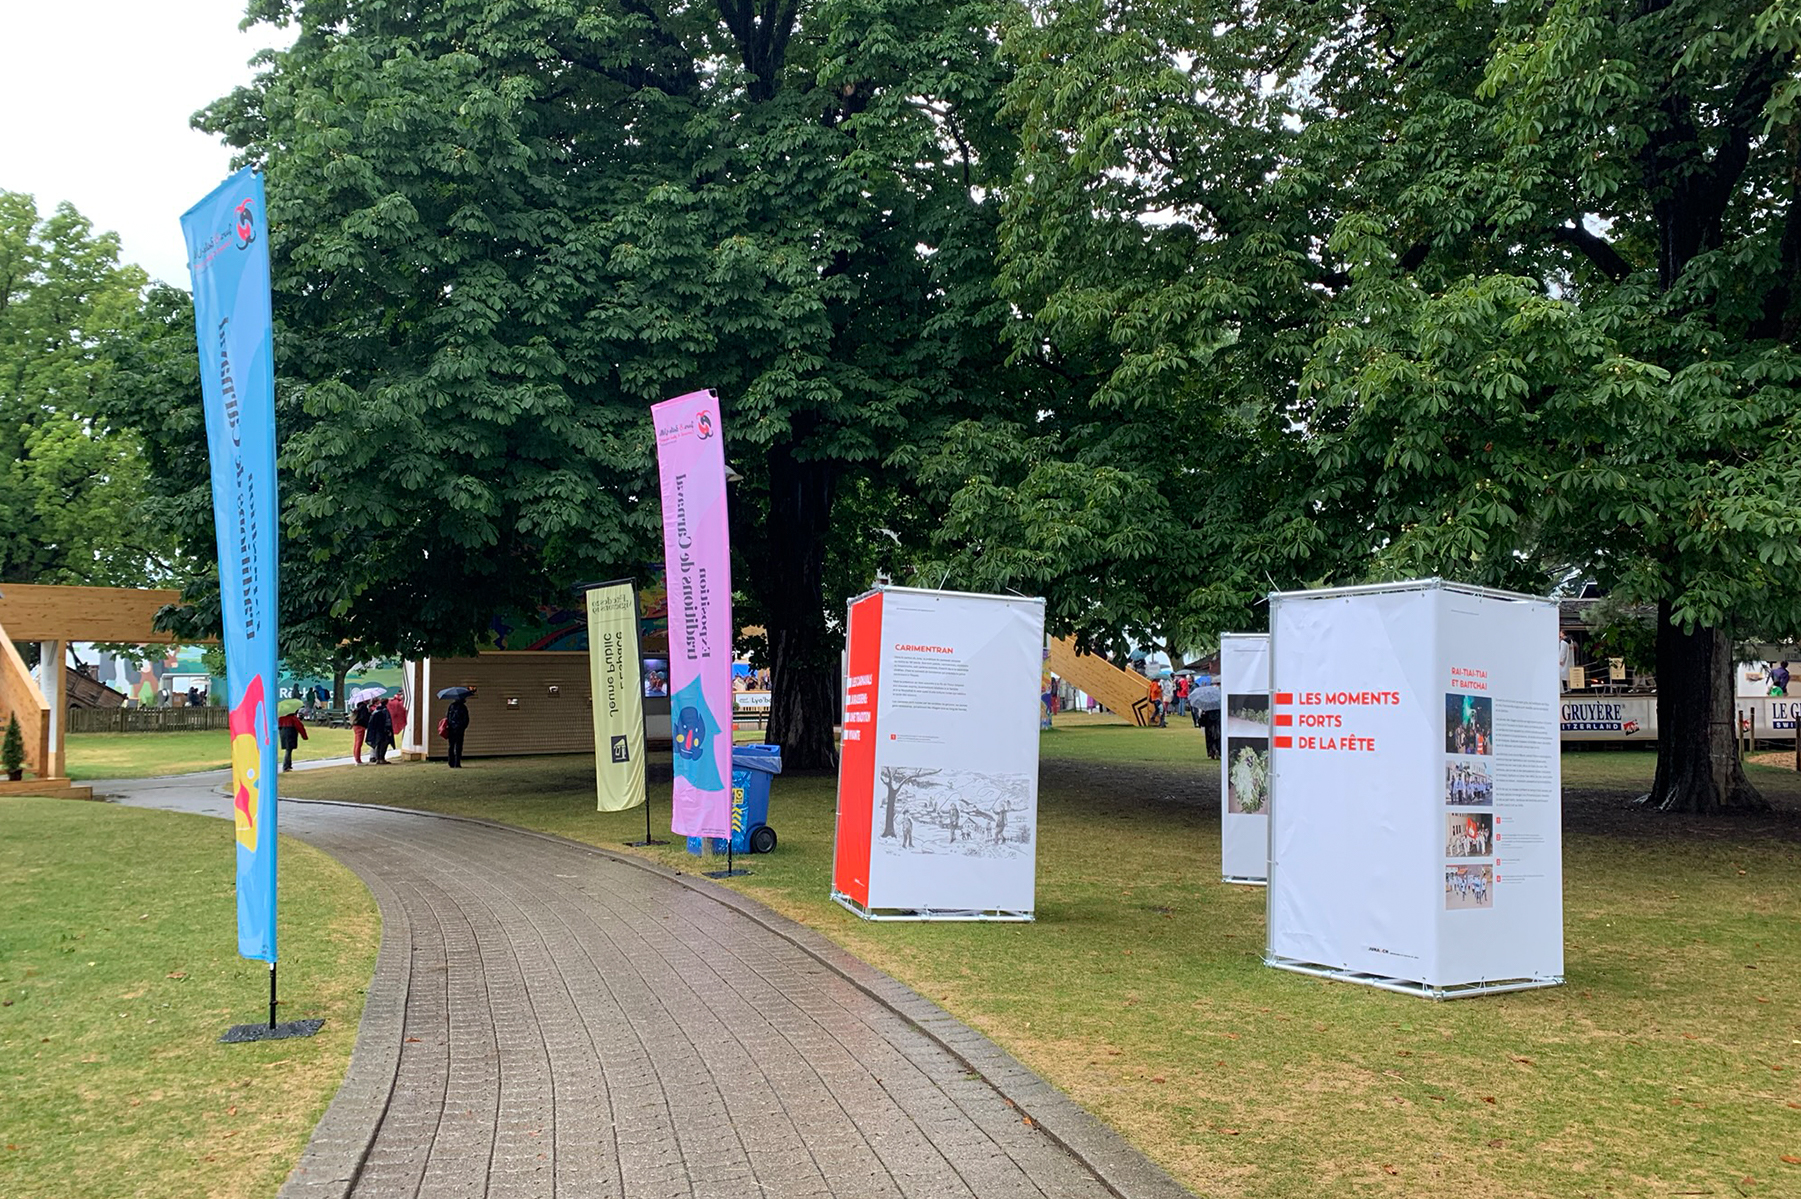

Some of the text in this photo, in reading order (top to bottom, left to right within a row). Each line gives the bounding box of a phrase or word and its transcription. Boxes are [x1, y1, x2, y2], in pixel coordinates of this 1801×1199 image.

[894, 643, 954, 654] CARIMENTRAN
[1451, 679, 1458, 687] ET
[1298, 691, 1400, 706] LES MOMENTS
[1562, 700, 1622, 721] GRUYÈRE
[1772, 702, 1801, 719] LE G
[1298, 714, 1342, 728] FORTS
[1298, 733, 1376, 751] DE LA FÊTE
